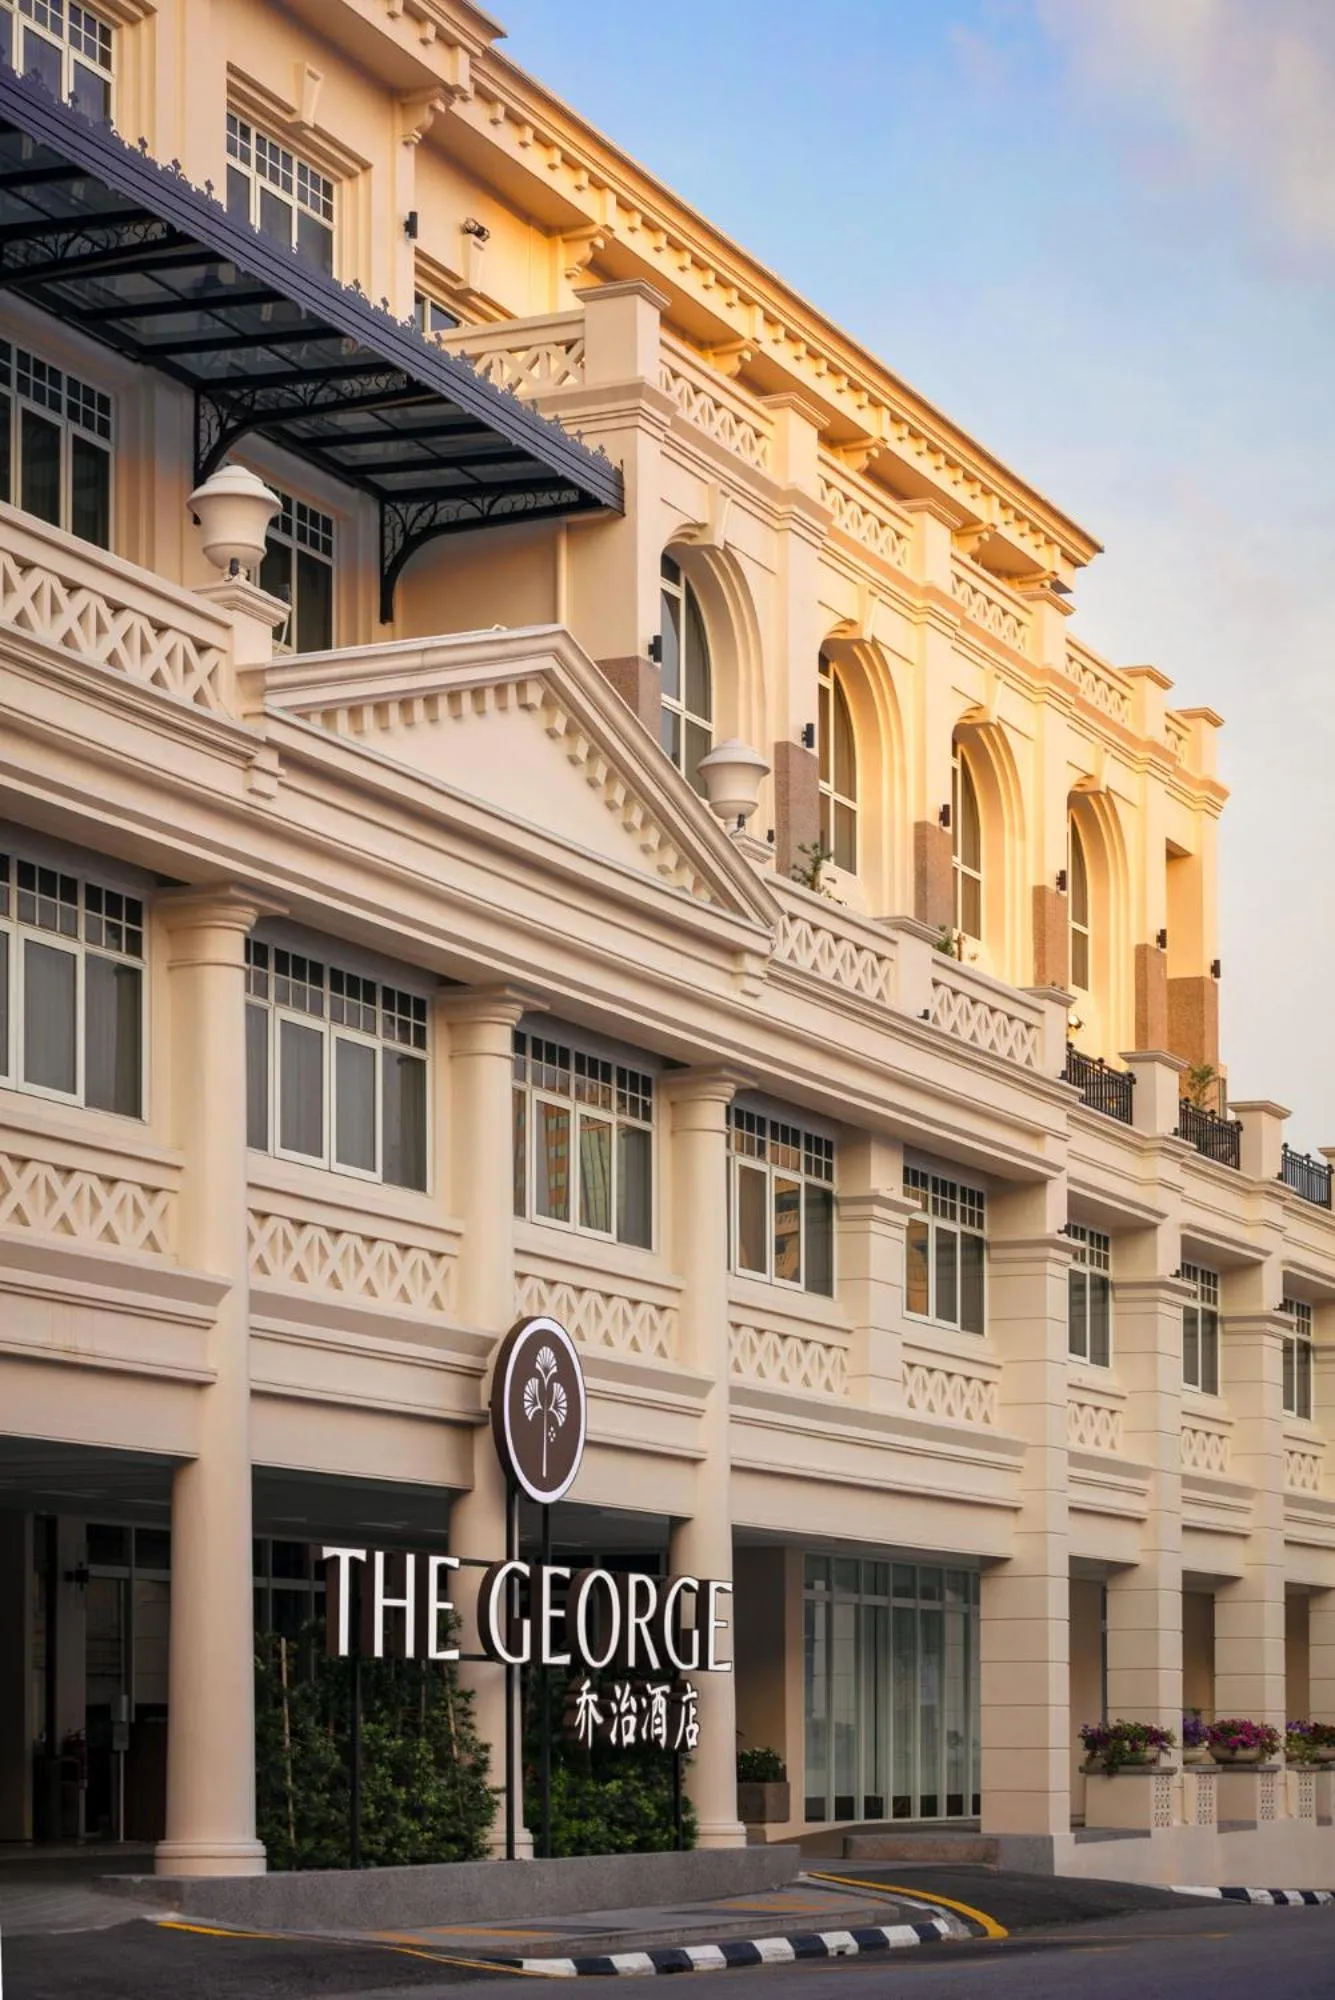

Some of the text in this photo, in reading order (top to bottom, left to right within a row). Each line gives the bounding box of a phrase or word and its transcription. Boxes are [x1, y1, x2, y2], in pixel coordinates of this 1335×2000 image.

[322, 1546, 734, 1672] THE GEORGE
[574, 1679, 700, 1750] 乔治酒店
